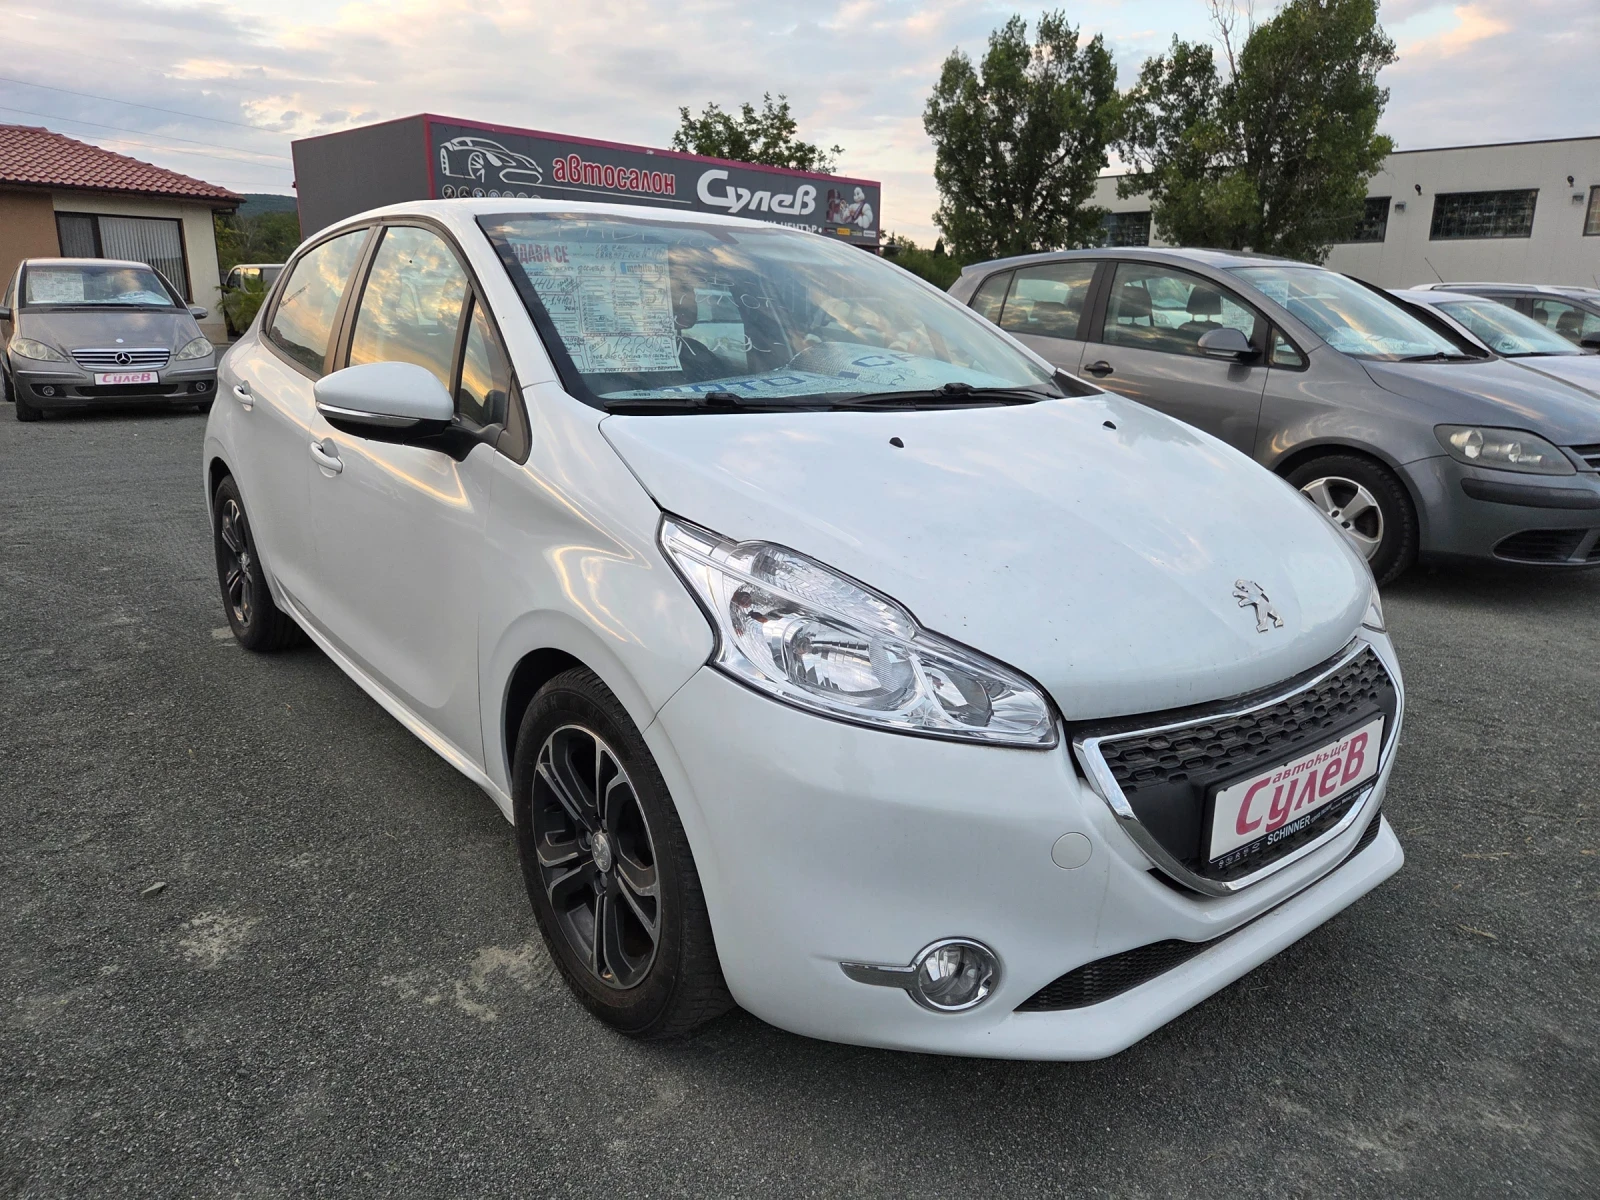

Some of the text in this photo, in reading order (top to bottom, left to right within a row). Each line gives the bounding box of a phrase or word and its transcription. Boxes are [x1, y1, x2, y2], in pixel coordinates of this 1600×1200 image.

[553, 153, 676, 195] автосалон
[1271, 740, 1349, 785] автокъща
[1267, 815, 1311, 846] SCHINNER
